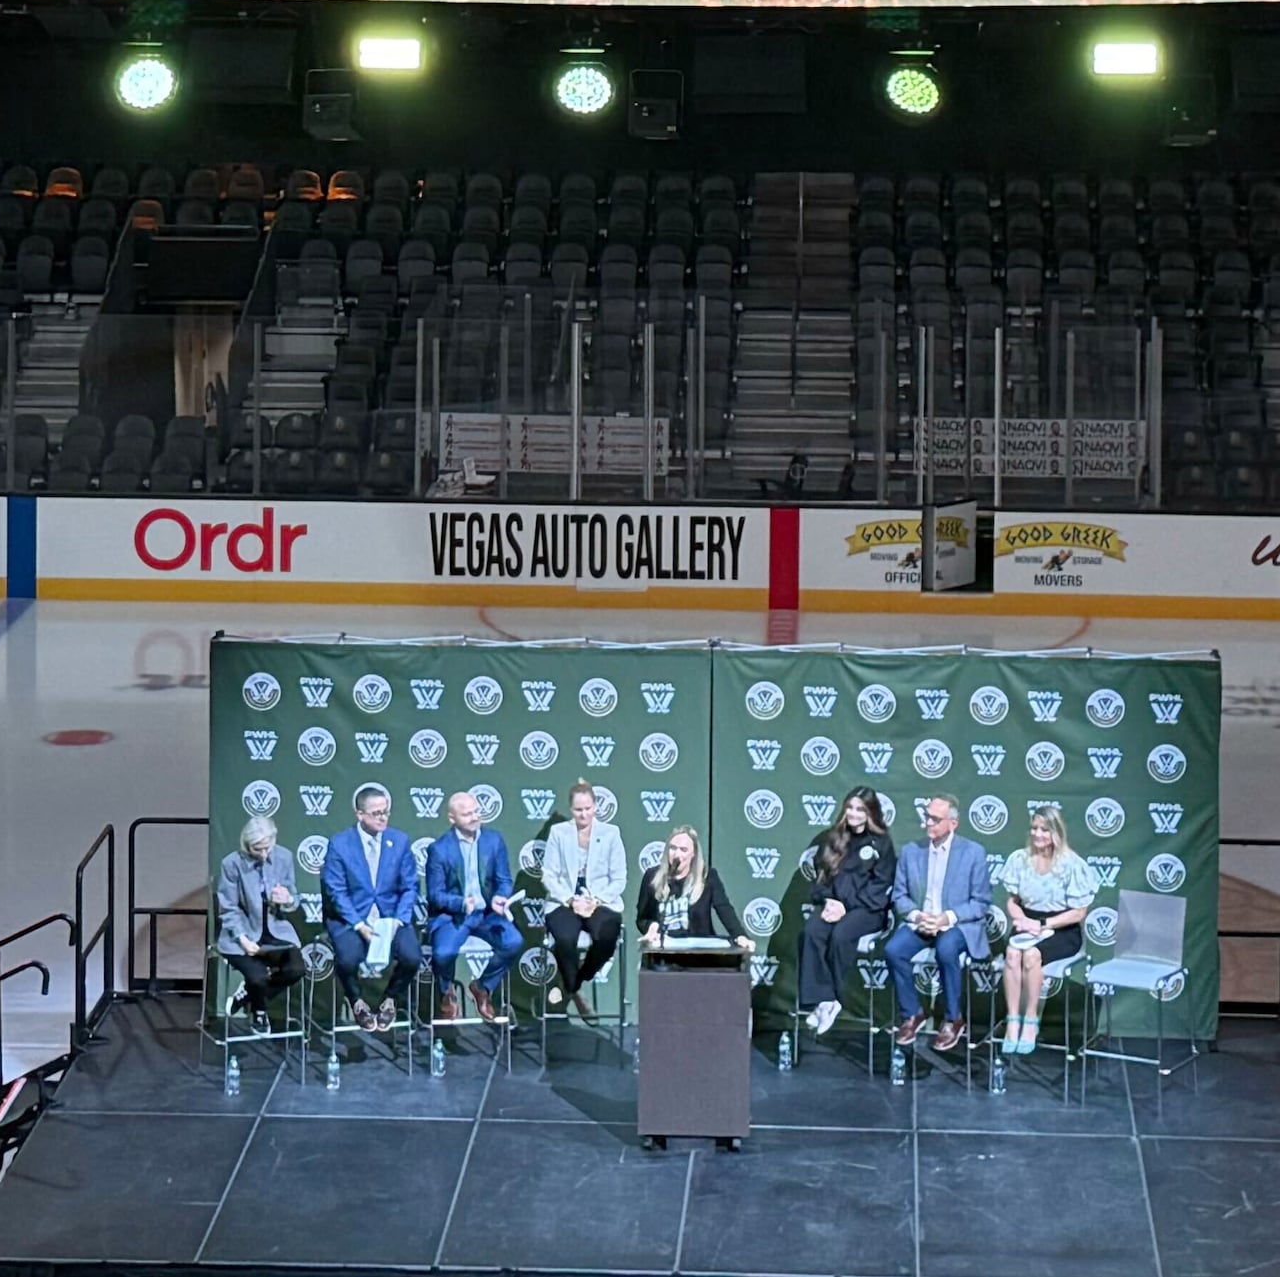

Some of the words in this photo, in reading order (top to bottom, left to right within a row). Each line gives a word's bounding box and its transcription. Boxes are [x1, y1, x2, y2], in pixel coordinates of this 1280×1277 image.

[133, 506, 308, 574] Ordr
[861, 522, 909, 543] GOOD
[1005, 525, 1053, 545] GOOD
[1060, 525, 1115, 549] GREEK
[428, 511, 524, 578] VEGAS
[530, 512, 608, 579] AUTO
[615, 513, 747, 581] GALLERY
[1034, 573, 1083, 587] MOVERS
